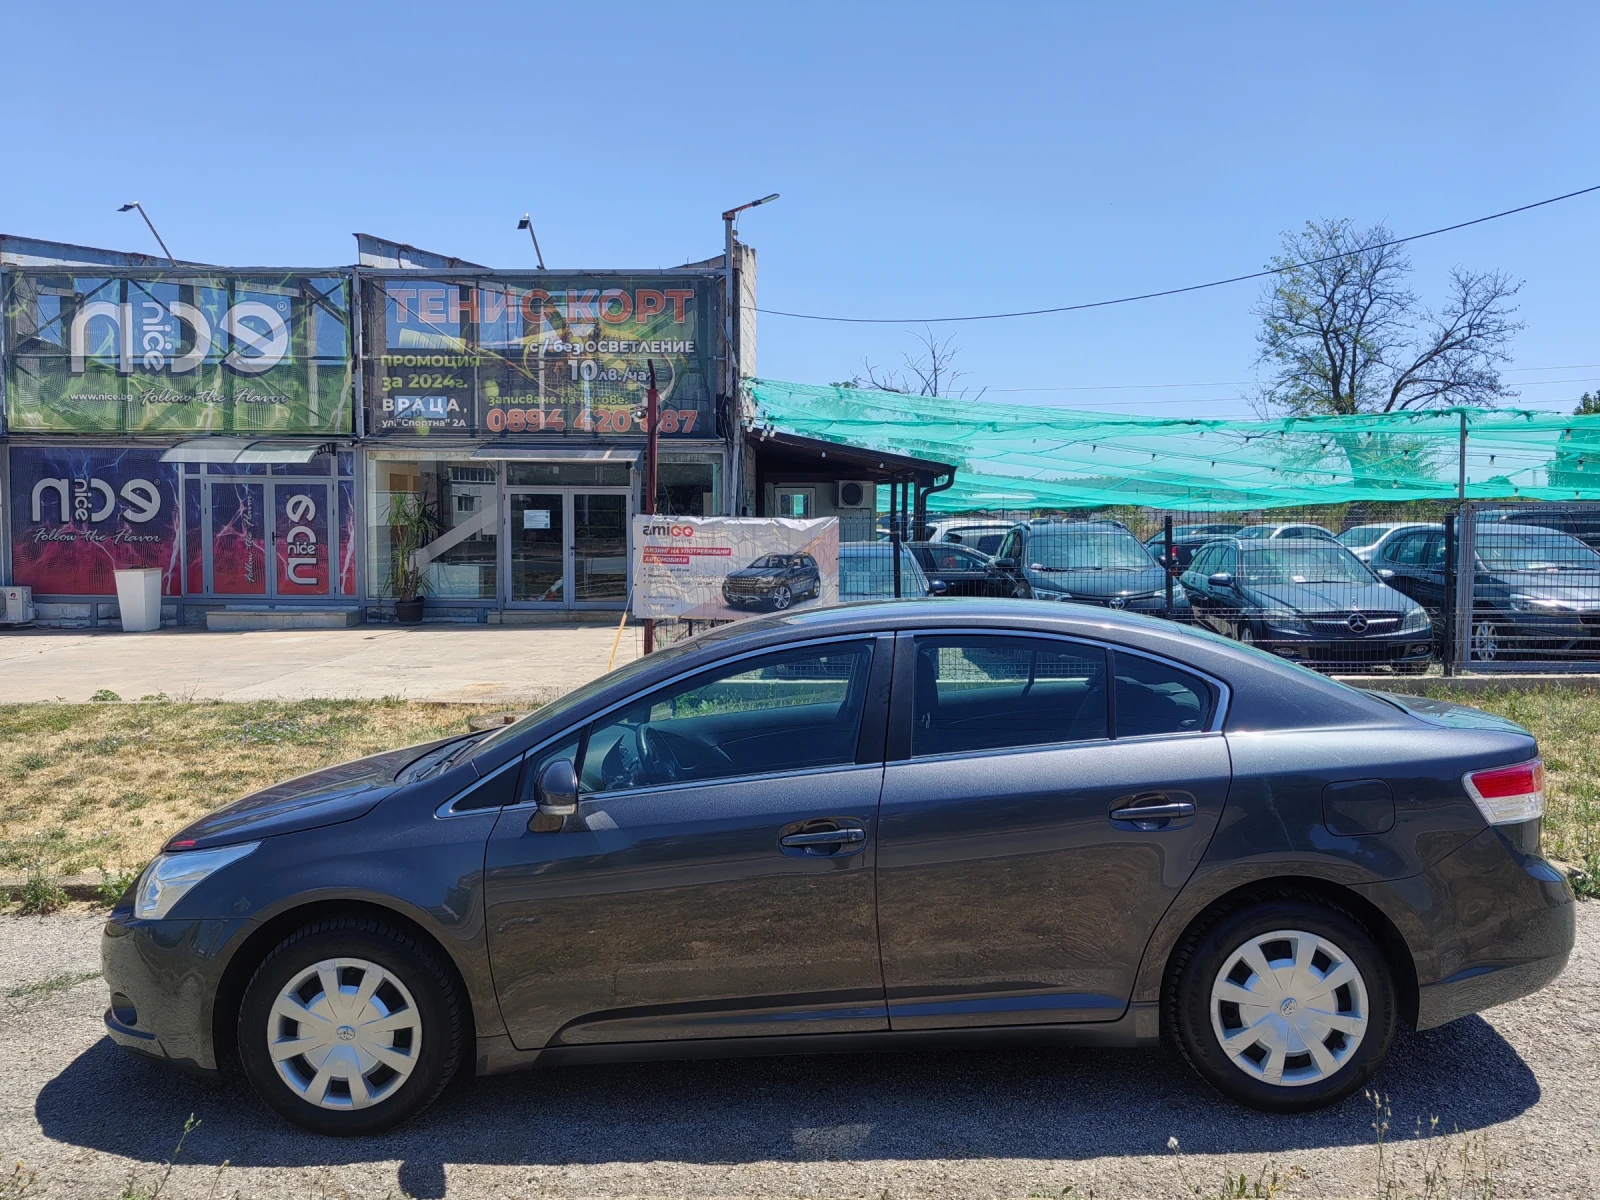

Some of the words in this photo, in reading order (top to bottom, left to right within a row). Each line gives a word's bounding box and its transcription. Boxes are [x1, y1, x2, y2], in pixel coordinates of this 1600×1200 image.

[386, 288, 550, 324] ТЕНИС
[565, 288, 695, 324] КОРТ
[584, 340, 695, 353] ОСВЕТЛЕНИЕ
[380, 354, 480, 369] ПРОМОЦИЯ
[382, 376, 403, 392] за
[408, 373, 468, 389] 2024г.
[70, 392, 134, 403] www.nice.bg
[140, 388, 191, 405] Follow
[196, 388, 226, 404] the
[232, 387, 289, 405] Flavor
[488, 394, 557, 407] записване
[560, 396, 576, 404] на
[579, 394, 629, 405] часове:
[382, 398, 467, 413] ВРАЦА,
[453, 419, 467, 427] 2А
[486, 408, 566, 432] 0894
[572, 408, 631, 433] 420
[33, 527, 77, 543] Follow
[83, 527, 109, 542] the
[113, 528, 162, 543] Flavor
[644, 556, 688, 564] АВТОМОБИЛИ
